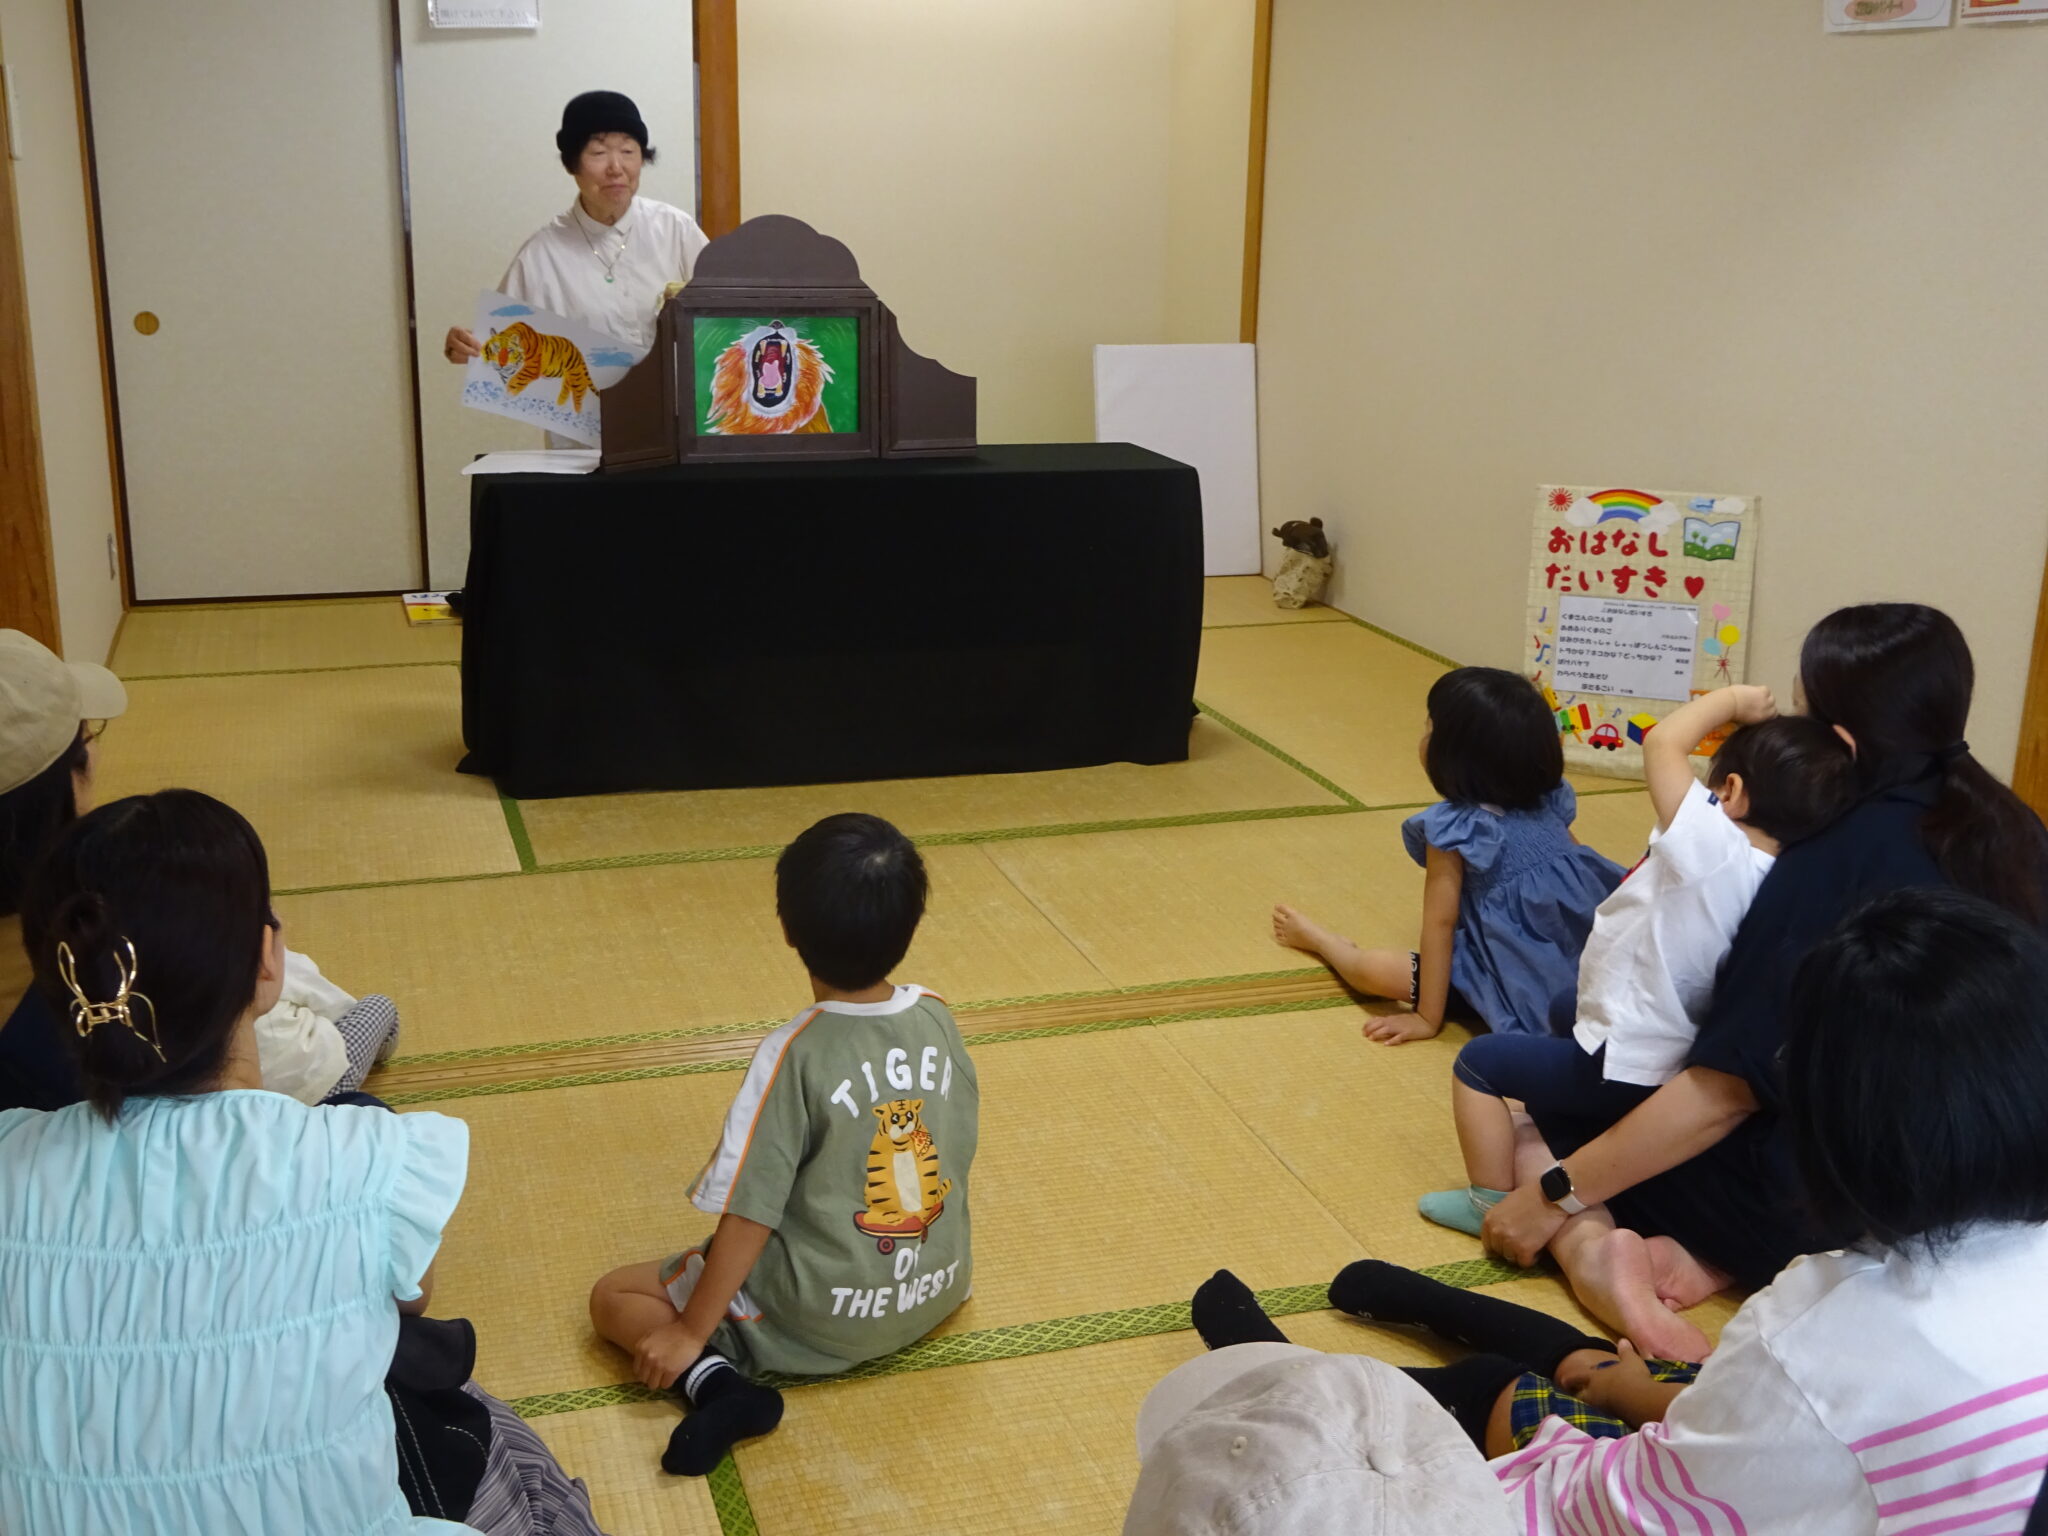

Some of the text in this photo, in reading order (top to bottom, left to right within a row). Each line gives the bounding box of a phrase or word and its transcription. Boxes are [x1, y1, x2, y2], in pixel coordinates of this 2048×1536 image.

[1548, 526, 1668, 557] おはなし
[1545, 563, 1667, 598] だいすき
[831, 1260, 959, 1318] THE WEST
